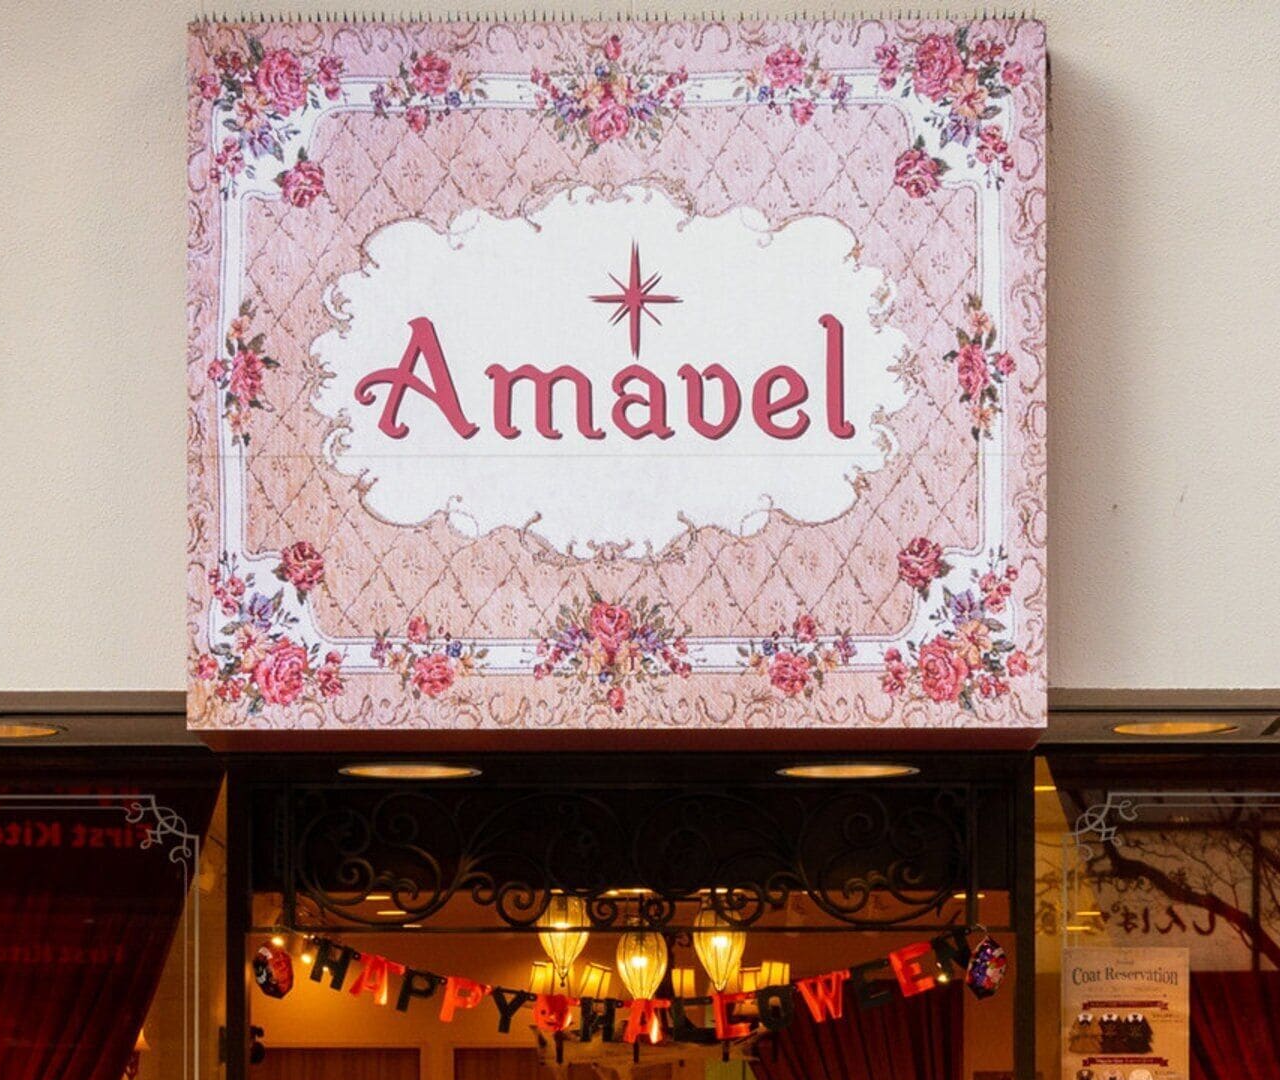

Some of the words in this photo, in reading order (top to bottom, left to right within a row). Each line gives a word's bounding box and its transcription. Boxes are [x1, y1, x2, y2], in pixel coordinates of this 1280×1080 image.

[353, 313, 856, 441] Amavel
[309, 938, 528, 1034] HAPPY
[1072, 966, 1101, 985] Coat
[1105, 966, 1179, 985] Reservation
